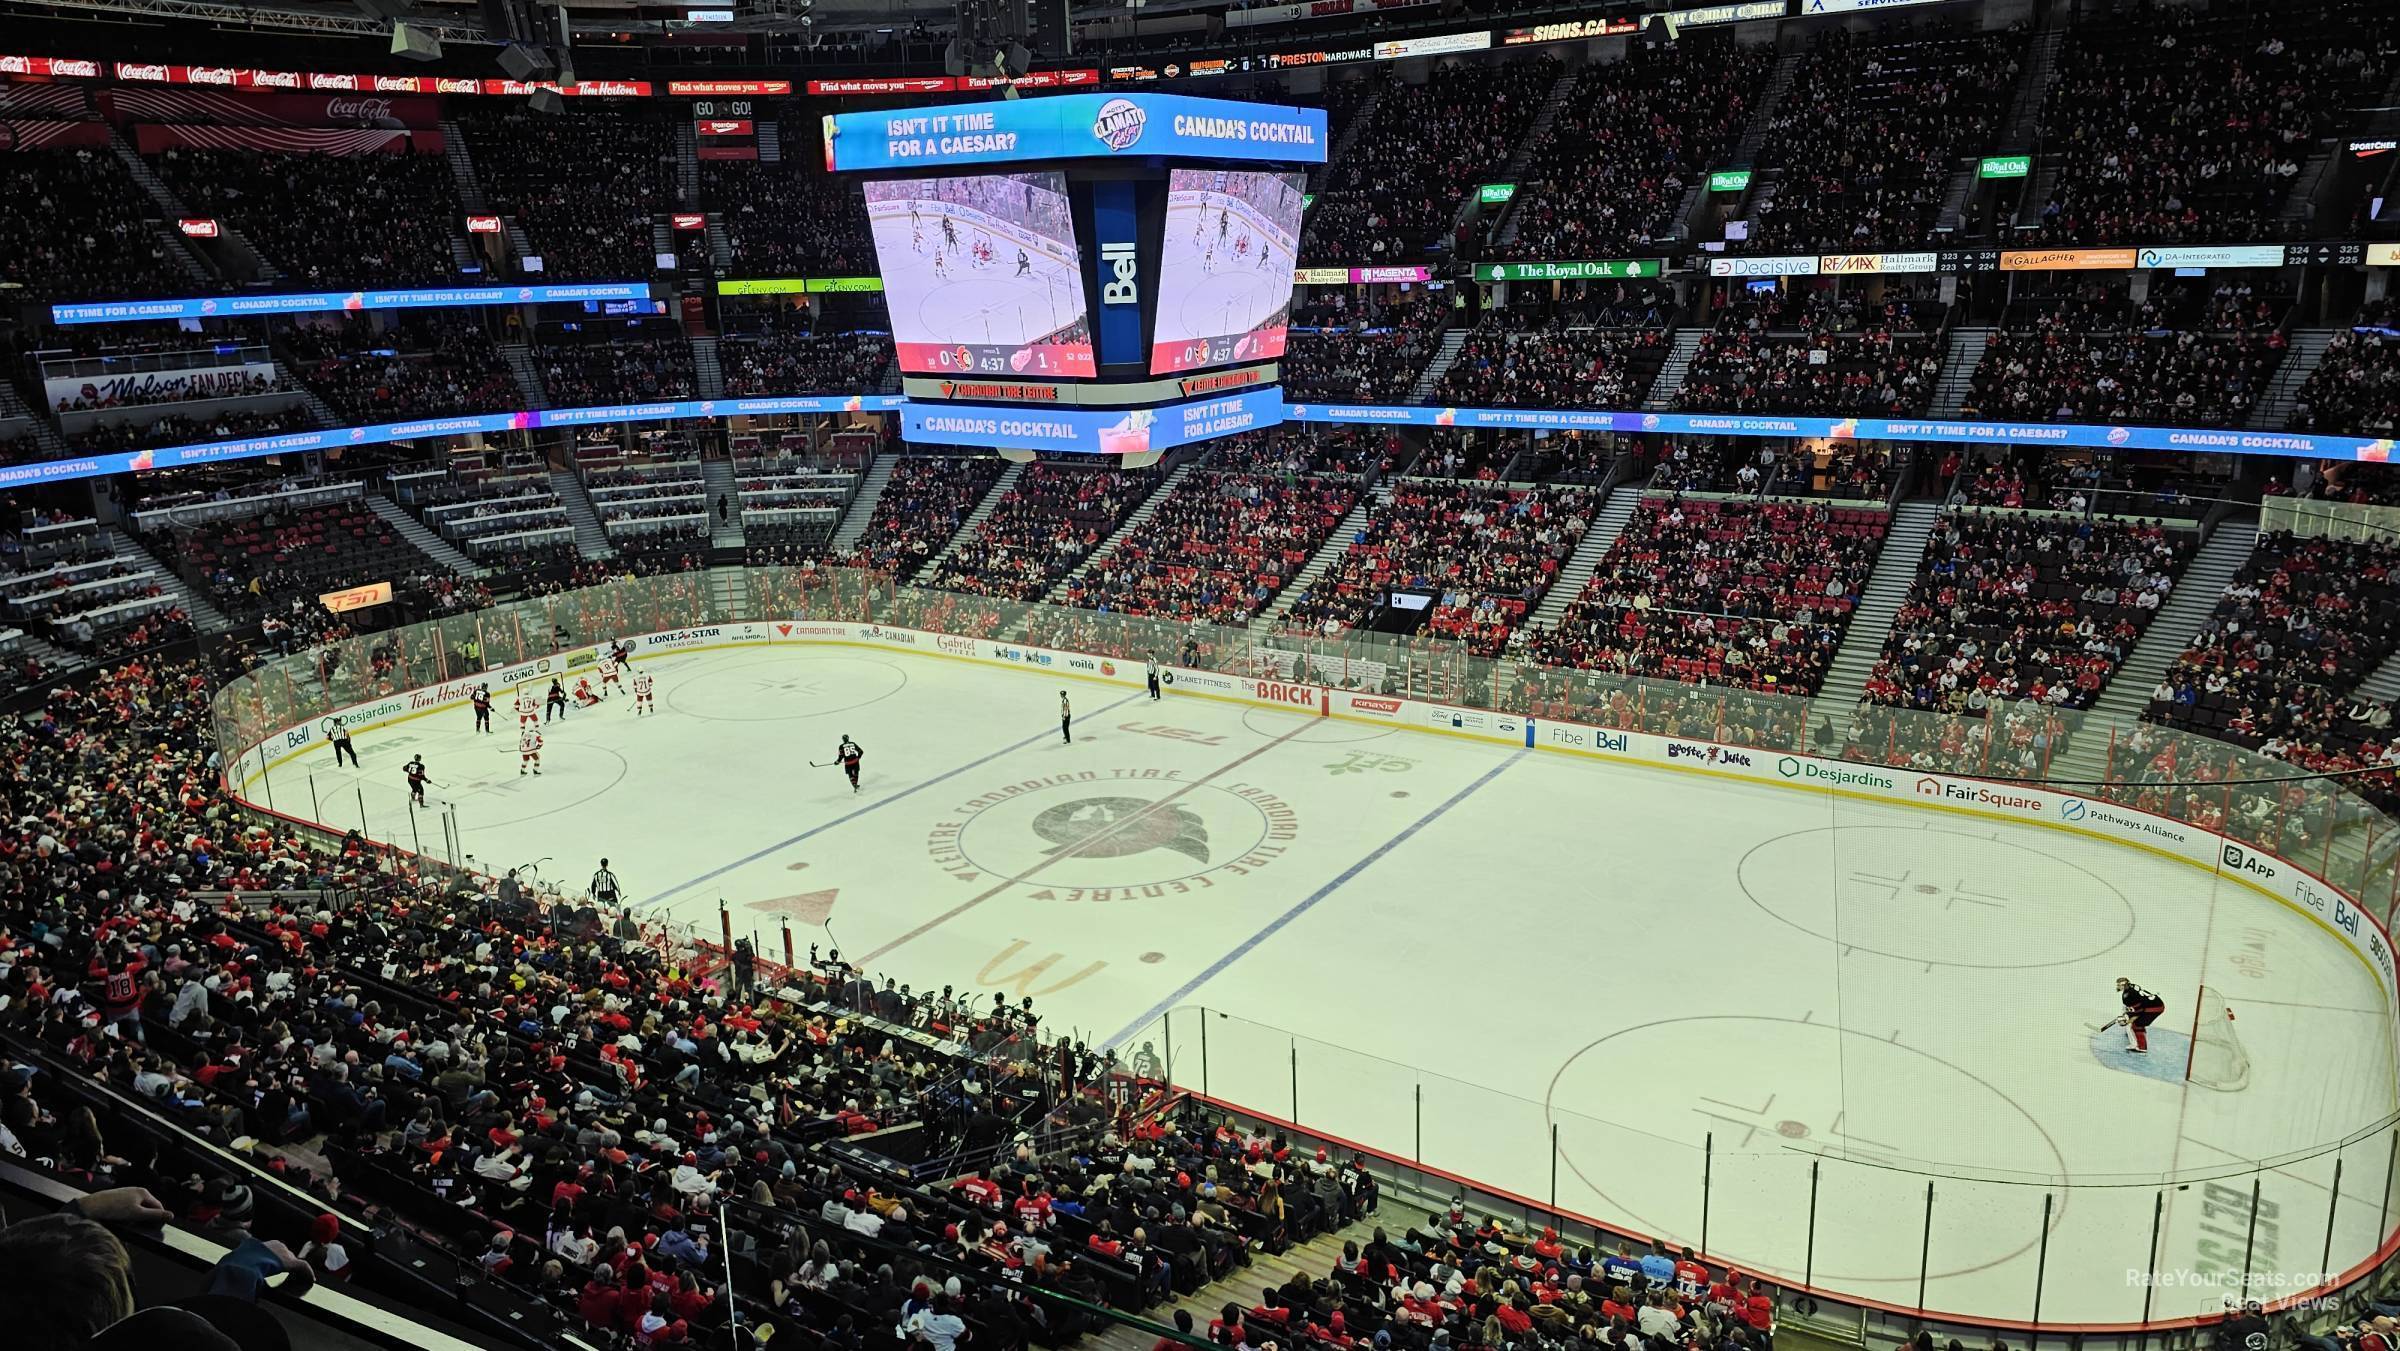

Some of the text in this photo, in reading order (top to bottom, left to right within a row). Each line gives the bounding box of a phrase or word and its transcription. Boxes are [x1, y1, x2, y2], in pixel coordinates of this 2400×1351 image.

[1533, 19, 1606, 41] SIGNS.CA
[53, 61, 96, 77] Coca-Cola
[121, 63, 166, 81] Coca-Cola
[190, 66, 232, 84] Coca-Cola
[256, 69, 297, 87] Coca-Cola
[313, 76, 353, 90] Coca-Cola
[377, 78, 417, 91] Coca-Cola
[969, 78, 986, 87] Find
[439, 80, 477, 93] Coca-Cola
[502, 80, 523, 94] Tim
[578, 81, 637, 96] Tim Hortons
[672, 82, 758, 93] Find what moves you
[820, 82, 840, 92] Find
[840, 82, 861, 91] what
[889, 82, 905, 92] you
[326, 97, 392, 121] Coca-Cola
[696, 101, 752, 115] GO GO!
[887, 112, 994, 136] ISN'T IT TIME
[1174, 115, 1314, 144] CANADA'S COCKTAIL
[888, 133, 1016, 157] FOR A CAESAR?
[2349, 141, 2397, 151] SPORTCHEK
[1983, 162, 2007, 174] Royal
[2007, 162, 2027, 171] Oak
[1942, 252, 1958, 260] 323
[1980, 252, 1996, 260] 324
[2014, 254, 2075, 265] GALLAGHER
[2289, 251, 2310, 260] 324
[2339, 250, 2360, 259] 325
[1735, 259, 1810, 275] Decisive
[1823, 254, 1934, 271] RE/MAX Hallmark
[1880, 263, 1934, 273] Realty Group
[1940, 263, 1957, 271] 223
[1978, 263, 1995, 271] 224
[2288, 262, 2308, 270] 224
[2338, 261, 2358, 270] 225
[1101, 242, 1138, 305] Bell
[1310, 270, 1346, 278] Hallmark
[1372, 268, 1417, 279] MAGENTA
[1518, 262, 1612, 279] The Royal Oak
[375, 291, 503, 304] ISN'T IT TIME FOR A CAESAR?
[546, 288, 633, 299] CANADA'S COCKTAIL
[231, 297, 328, 310] CANADA'S COCKTAIL
[995, 347, 1001, 355] 1
[1251, 338, 1258, 353] 1
[940, 350, 950, 367] 0
[1038, 352, 1048, 368] 1
[1185, 347, 1192, 362] 0
[1212, 347, 1230, 362] 4:37
[980, 357, 1005, 371] 4:37
[100, 371, 250, 399] Molson FAN DECK
[1000, 385, 1056, 400] TIRE CENTRE
[738, 400, 821, 410] CANADA'S COCKTAIL
[1184, 399, 1243, 422] ISN'T IT TIME
[1328, 409, 1411, 419] CANADA'S COCKTAIL
[925, 417, 1078, 439] CANADA'S COCKTAIL
[1184, 413, 1254, 438] FOR A CAESAR?
[1689, 419, 1798, 431] CANADA'S COCKTAIL
[1887, 424, 2068, 439] ISN'T IT TIME FOR A CAESAR?
[180, 437, 322, 458] ISN'T IT TIME FOR A CAESAR?
[2170, 434, 2314, 451] CANADA'S COCKTAIL
[0, 466, 42, 480] NADA'S
[332, 589, 379, 609] TSN
[648, 628, 720, 646] LONE STAR
[796, 627, 846, 637] CANADIAN TIRE
[885, 631, 915, 644] CANADIAN
[665, 639, 705, 649] TEXAS GRILL
[936, 635, 976, 650] Gabriel
[1069, 659, 1094, 670] voilà
[502, 669, 535, 683] CASINO
[1176, 675, 1232, 689] PLANET FITNESS
[638, 680, 648, 690] 71
[1240, 679, 1312, 706] The BRICK
[408, 691, 434, 710] Tim
[338, 701, 402, 727] Desjardins
[287, 725, 310, 749] Bell
[1553, 728, 1627, 752] Fibe Bell
[842, 743, 857, 757] 85
[1667, 743, 1751, 767] Booster Juice
[1806, 764, 1893, 789] Desjardins
[1946, 784, 2042, 811] FairSquare
[927, 768, 1182, 872] CENTRE CANADIAN TIRE
[2090, 810, 2185, 843] Pathways Alliance
[1065, 845, 1287, 902] TIRE CENTRE
[2295, 881, 2359, 937] Fibe Bell
[107, 979, 130, 999] 18
[1134, 1059, 1150, 1078] 72
[1108, 1086, 1129, 1105] 40
[1678, 1277, 1698, 1301] 14
